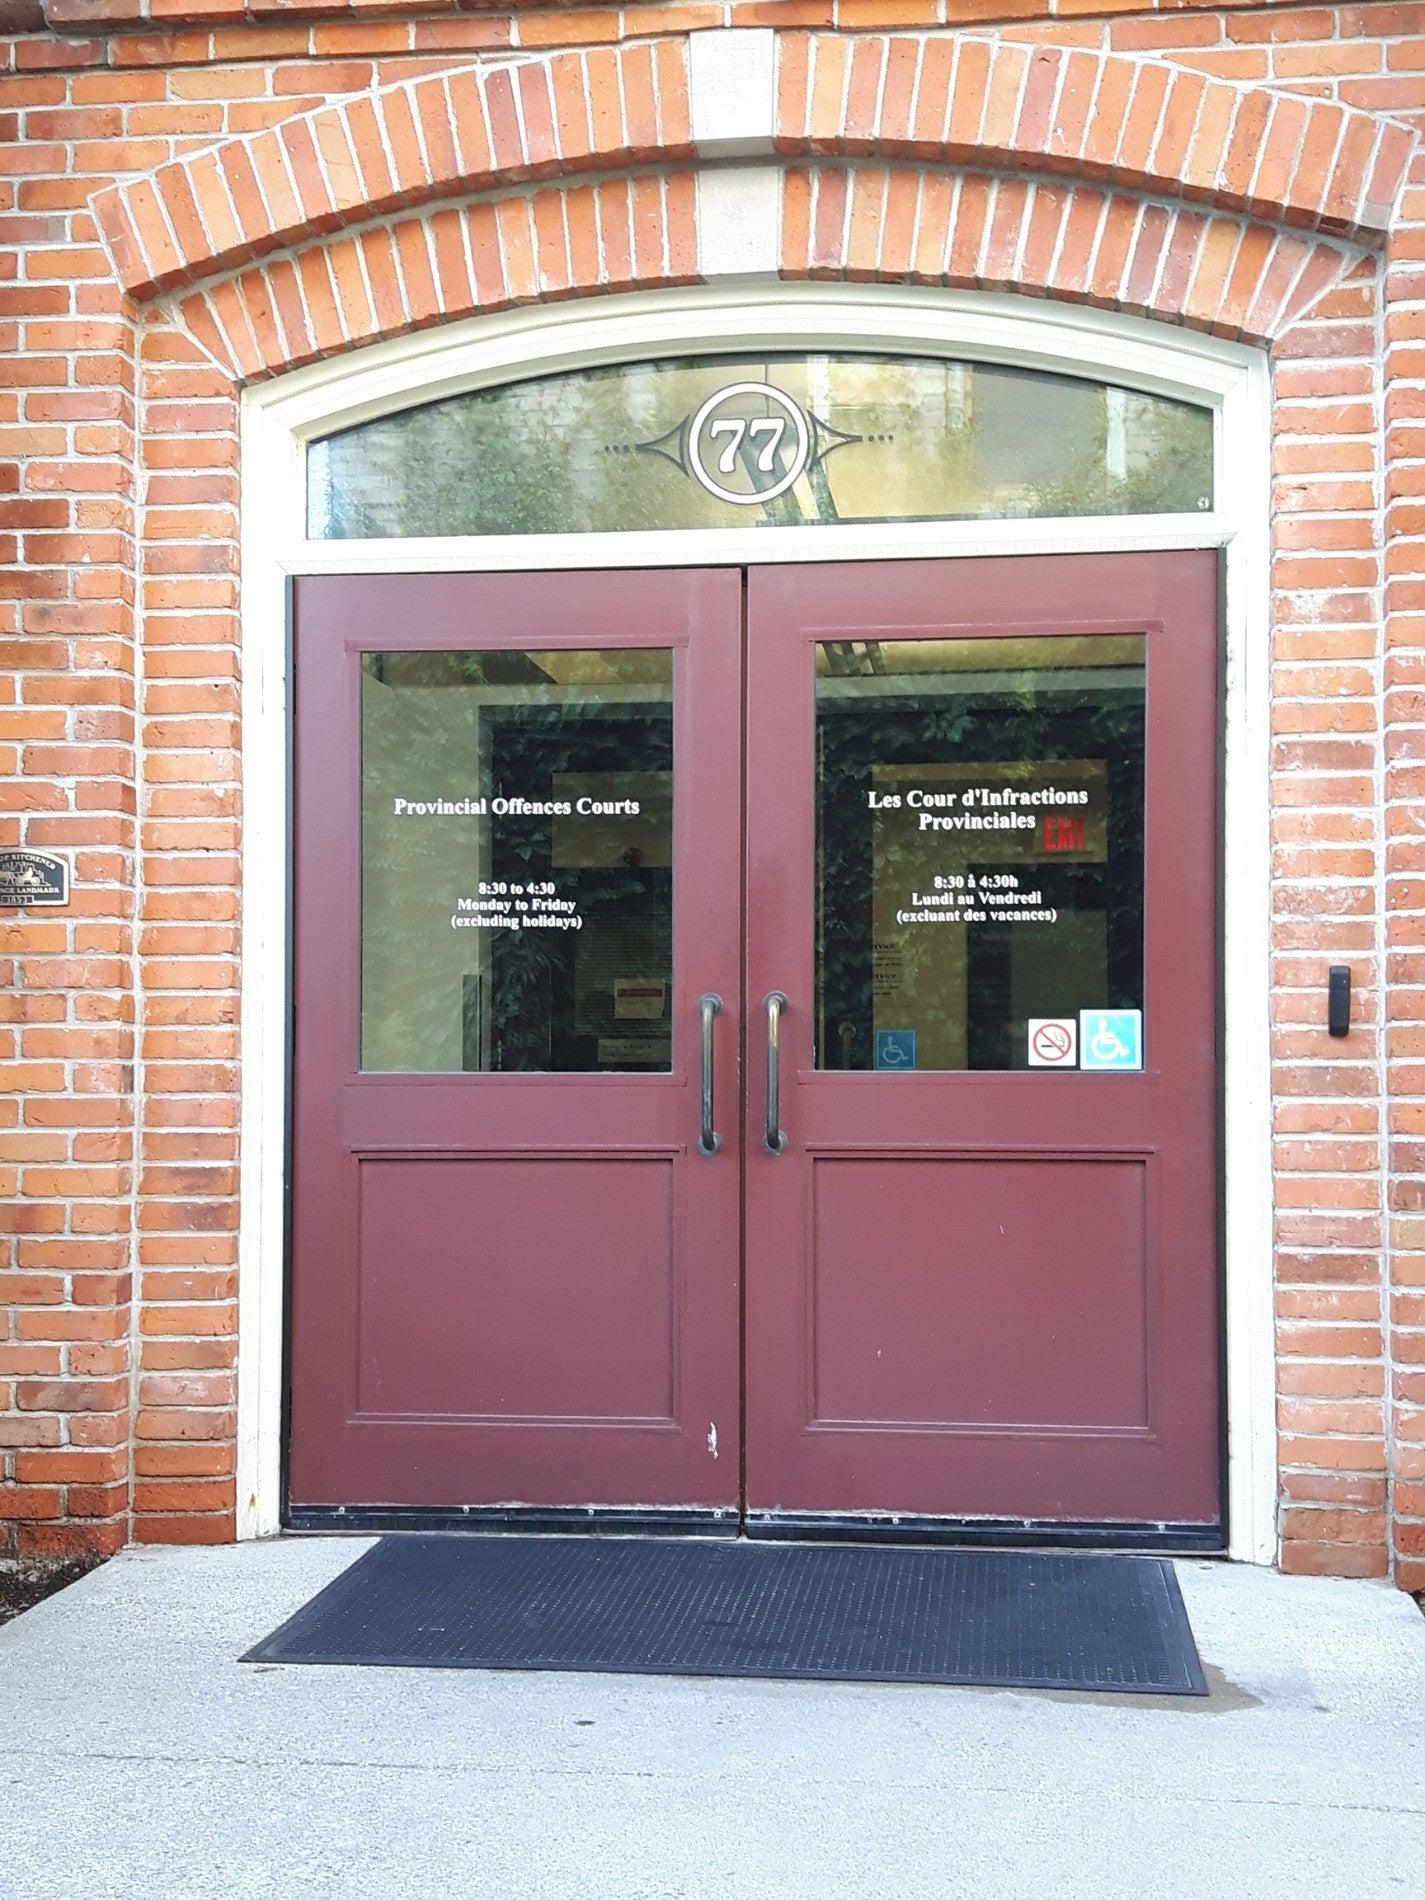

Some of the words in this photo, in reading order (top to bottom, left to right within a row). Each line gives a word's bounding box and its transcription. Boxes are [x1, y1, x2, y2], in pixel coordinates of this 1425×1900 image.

[709, 417, 786, 474] 77
[868, 791, 901, 809] Les
[906, 789, 957, 808] Cour
[961, 787, 1089, 807] d'Infractions
[393, 797, 487, 816] Provincial
[491, 797, 572, 815] Offences
[576, 797, 640, 815] Courts
[918, 811, 1036, 831] Provinciales
[1043, 816, 1085, 849] EXIT
[478, 882, 508, 895] 8:30
[510, 883, 524, 895] to
[526, 882, 556, 895] 4:30
[933, 875, 965, 889] 8:30
[967, 873, 976, 888] à
[979, 874, 1019, 889] 4:30h
[457, 898, 512, 914] Monday
[515, 899, 529, 911] to
[532, 898, 576, 914] Friday
[912, 891, 954, 906] Lundi
[957, 894, 975, 905] au
[978, 891, 1042, 905] Vendredi
[450, 914, 520, 930] (excluding
[522, 914, 583, 930] holidays)
[896, 908, 961, 924] (excluant
[963, 908, 987, 922] des
[989, 908, 1057, 923] vacances)
